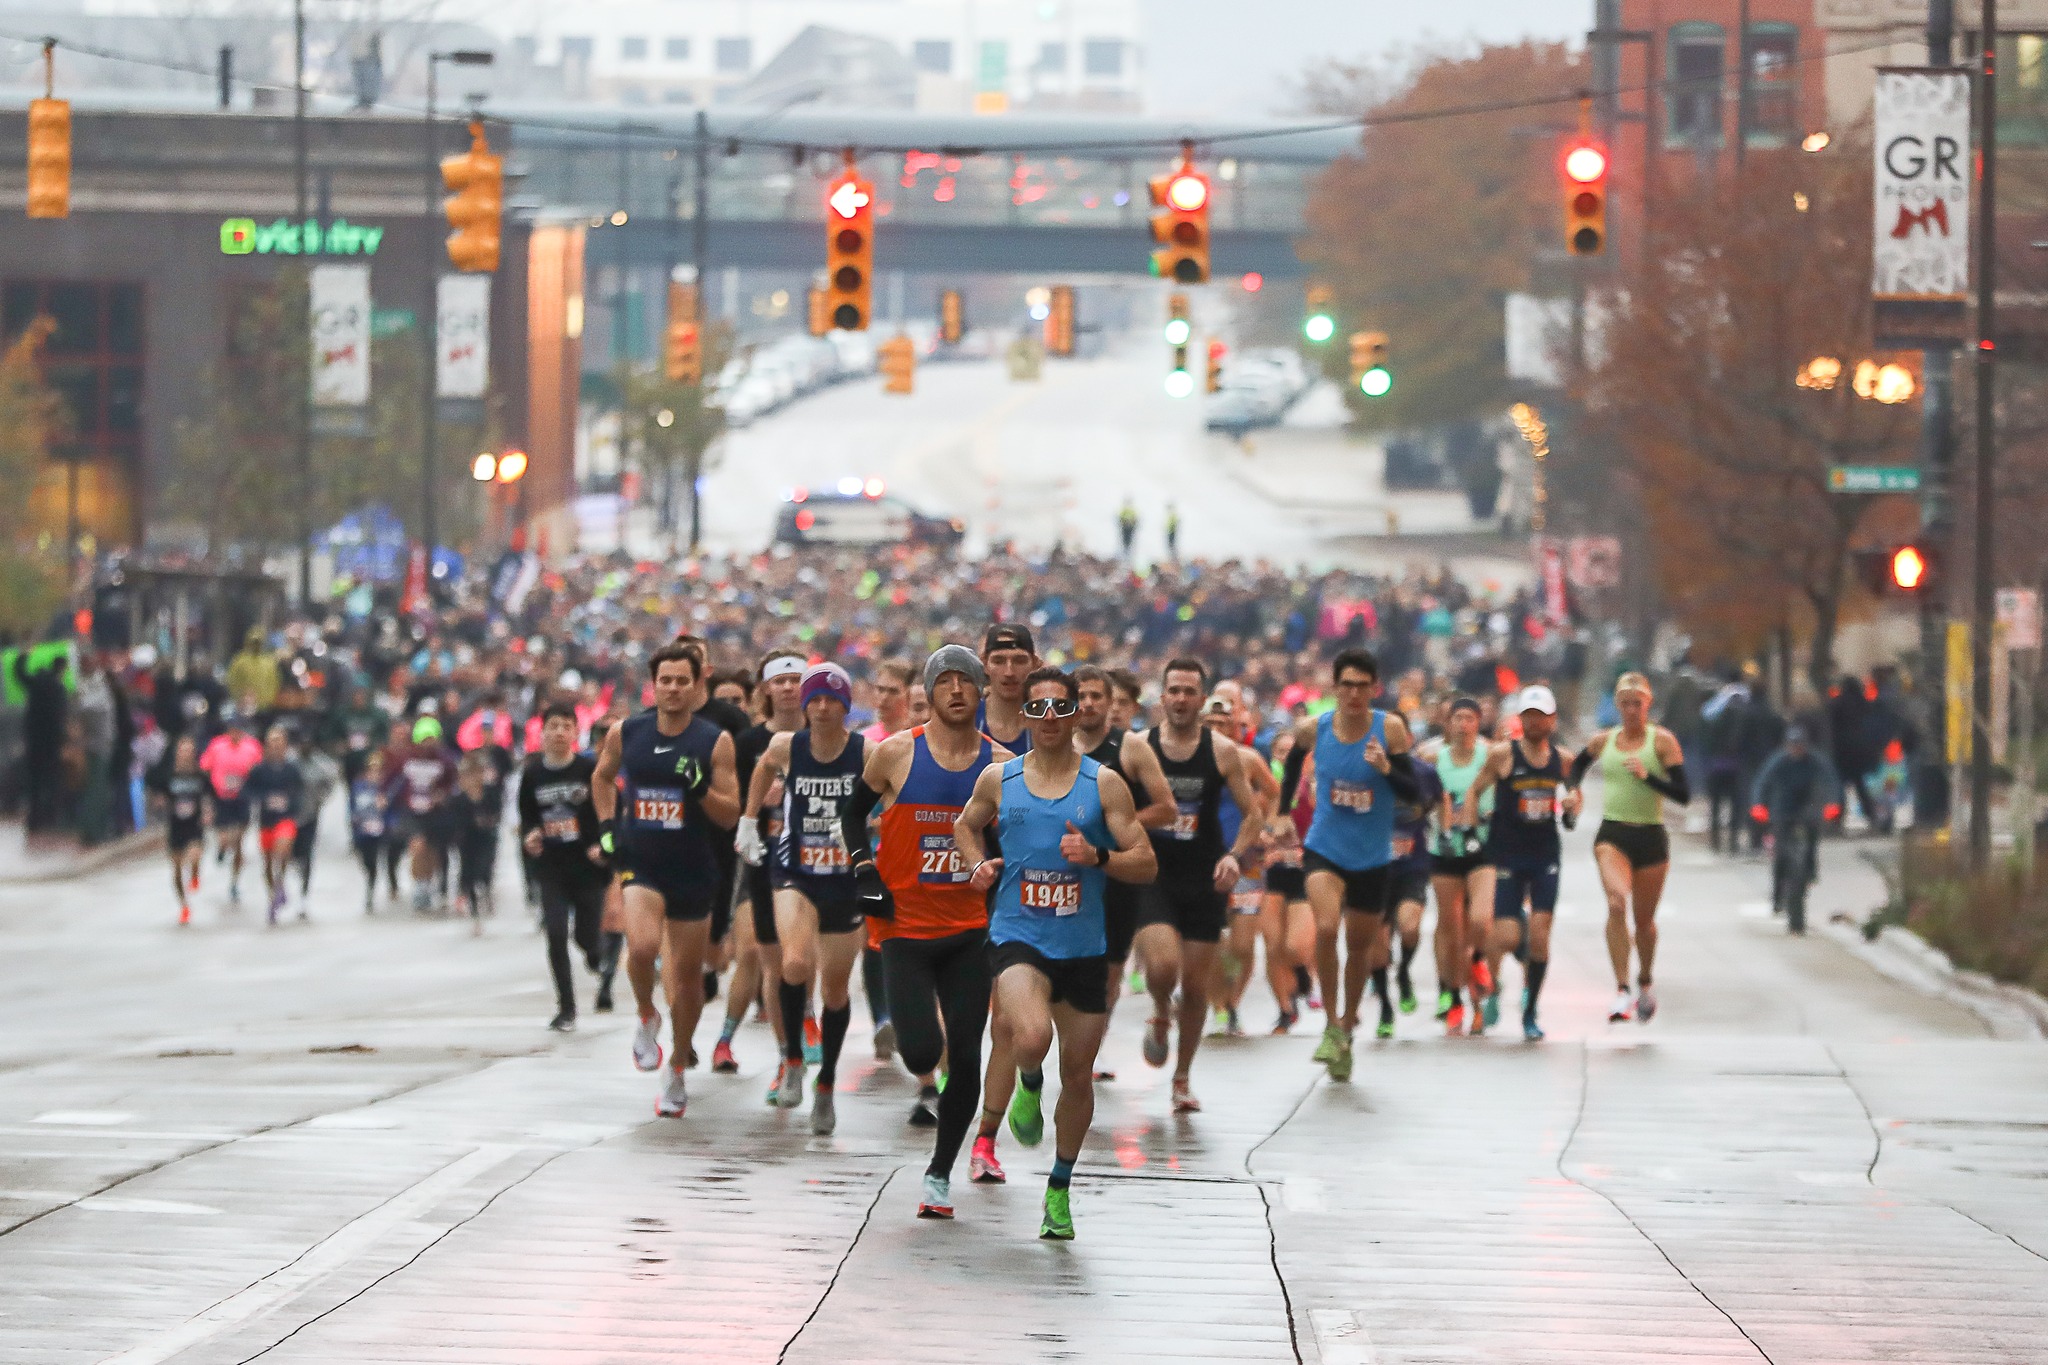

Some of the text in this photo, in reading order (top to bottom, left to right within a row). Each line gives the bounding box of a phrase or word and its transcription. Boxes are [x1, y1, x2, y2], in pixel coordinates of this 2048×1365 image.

[1884, 135, 1962, 181] GR
[795, 774, 856, 796] POTTER'S
[639, 801, 681, 820] 1332
[915, 810, 948, 823] COAST
[804, 847, 848, 866] 3213
[922, 851, 970, 873] 276
[1025, 883, 1079, 907] 1945
